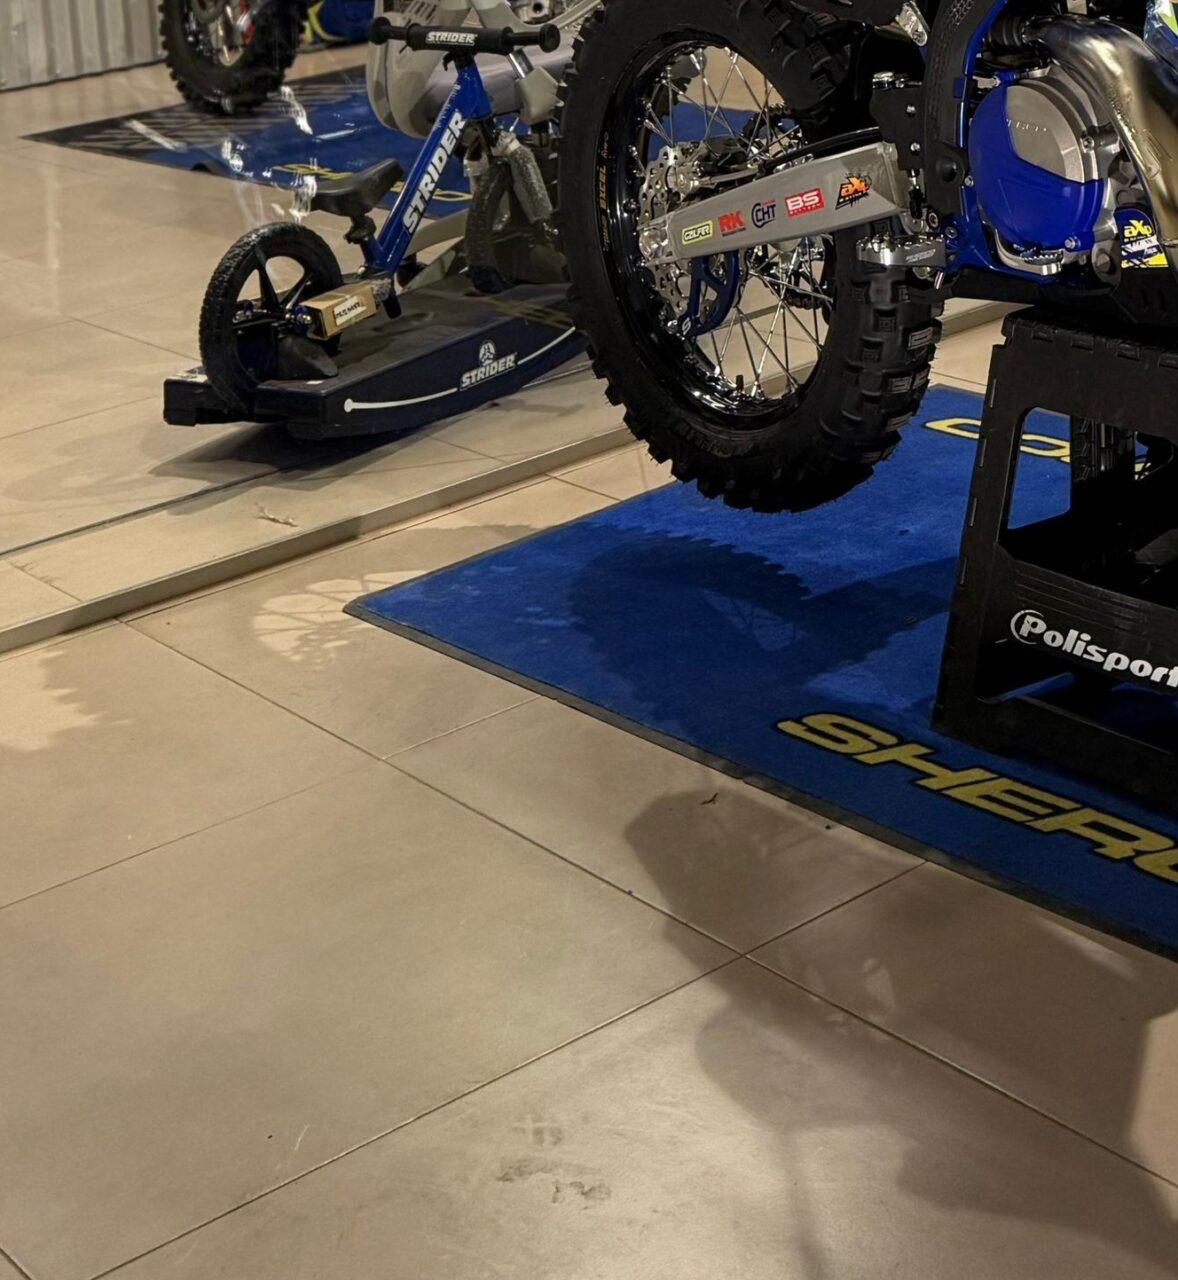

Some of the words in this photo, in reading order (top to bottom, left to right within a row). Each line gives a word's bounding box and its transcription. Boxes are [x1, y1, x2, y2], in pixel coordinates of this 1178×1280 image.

[427, 31, 475, 44] STRIDER
[403, 111, 466, 234] STRIDER
[787, 190, 820, 211] BS
[718, 211, 746, 232] RK
[462, 354, 516, 388] STRIDER
